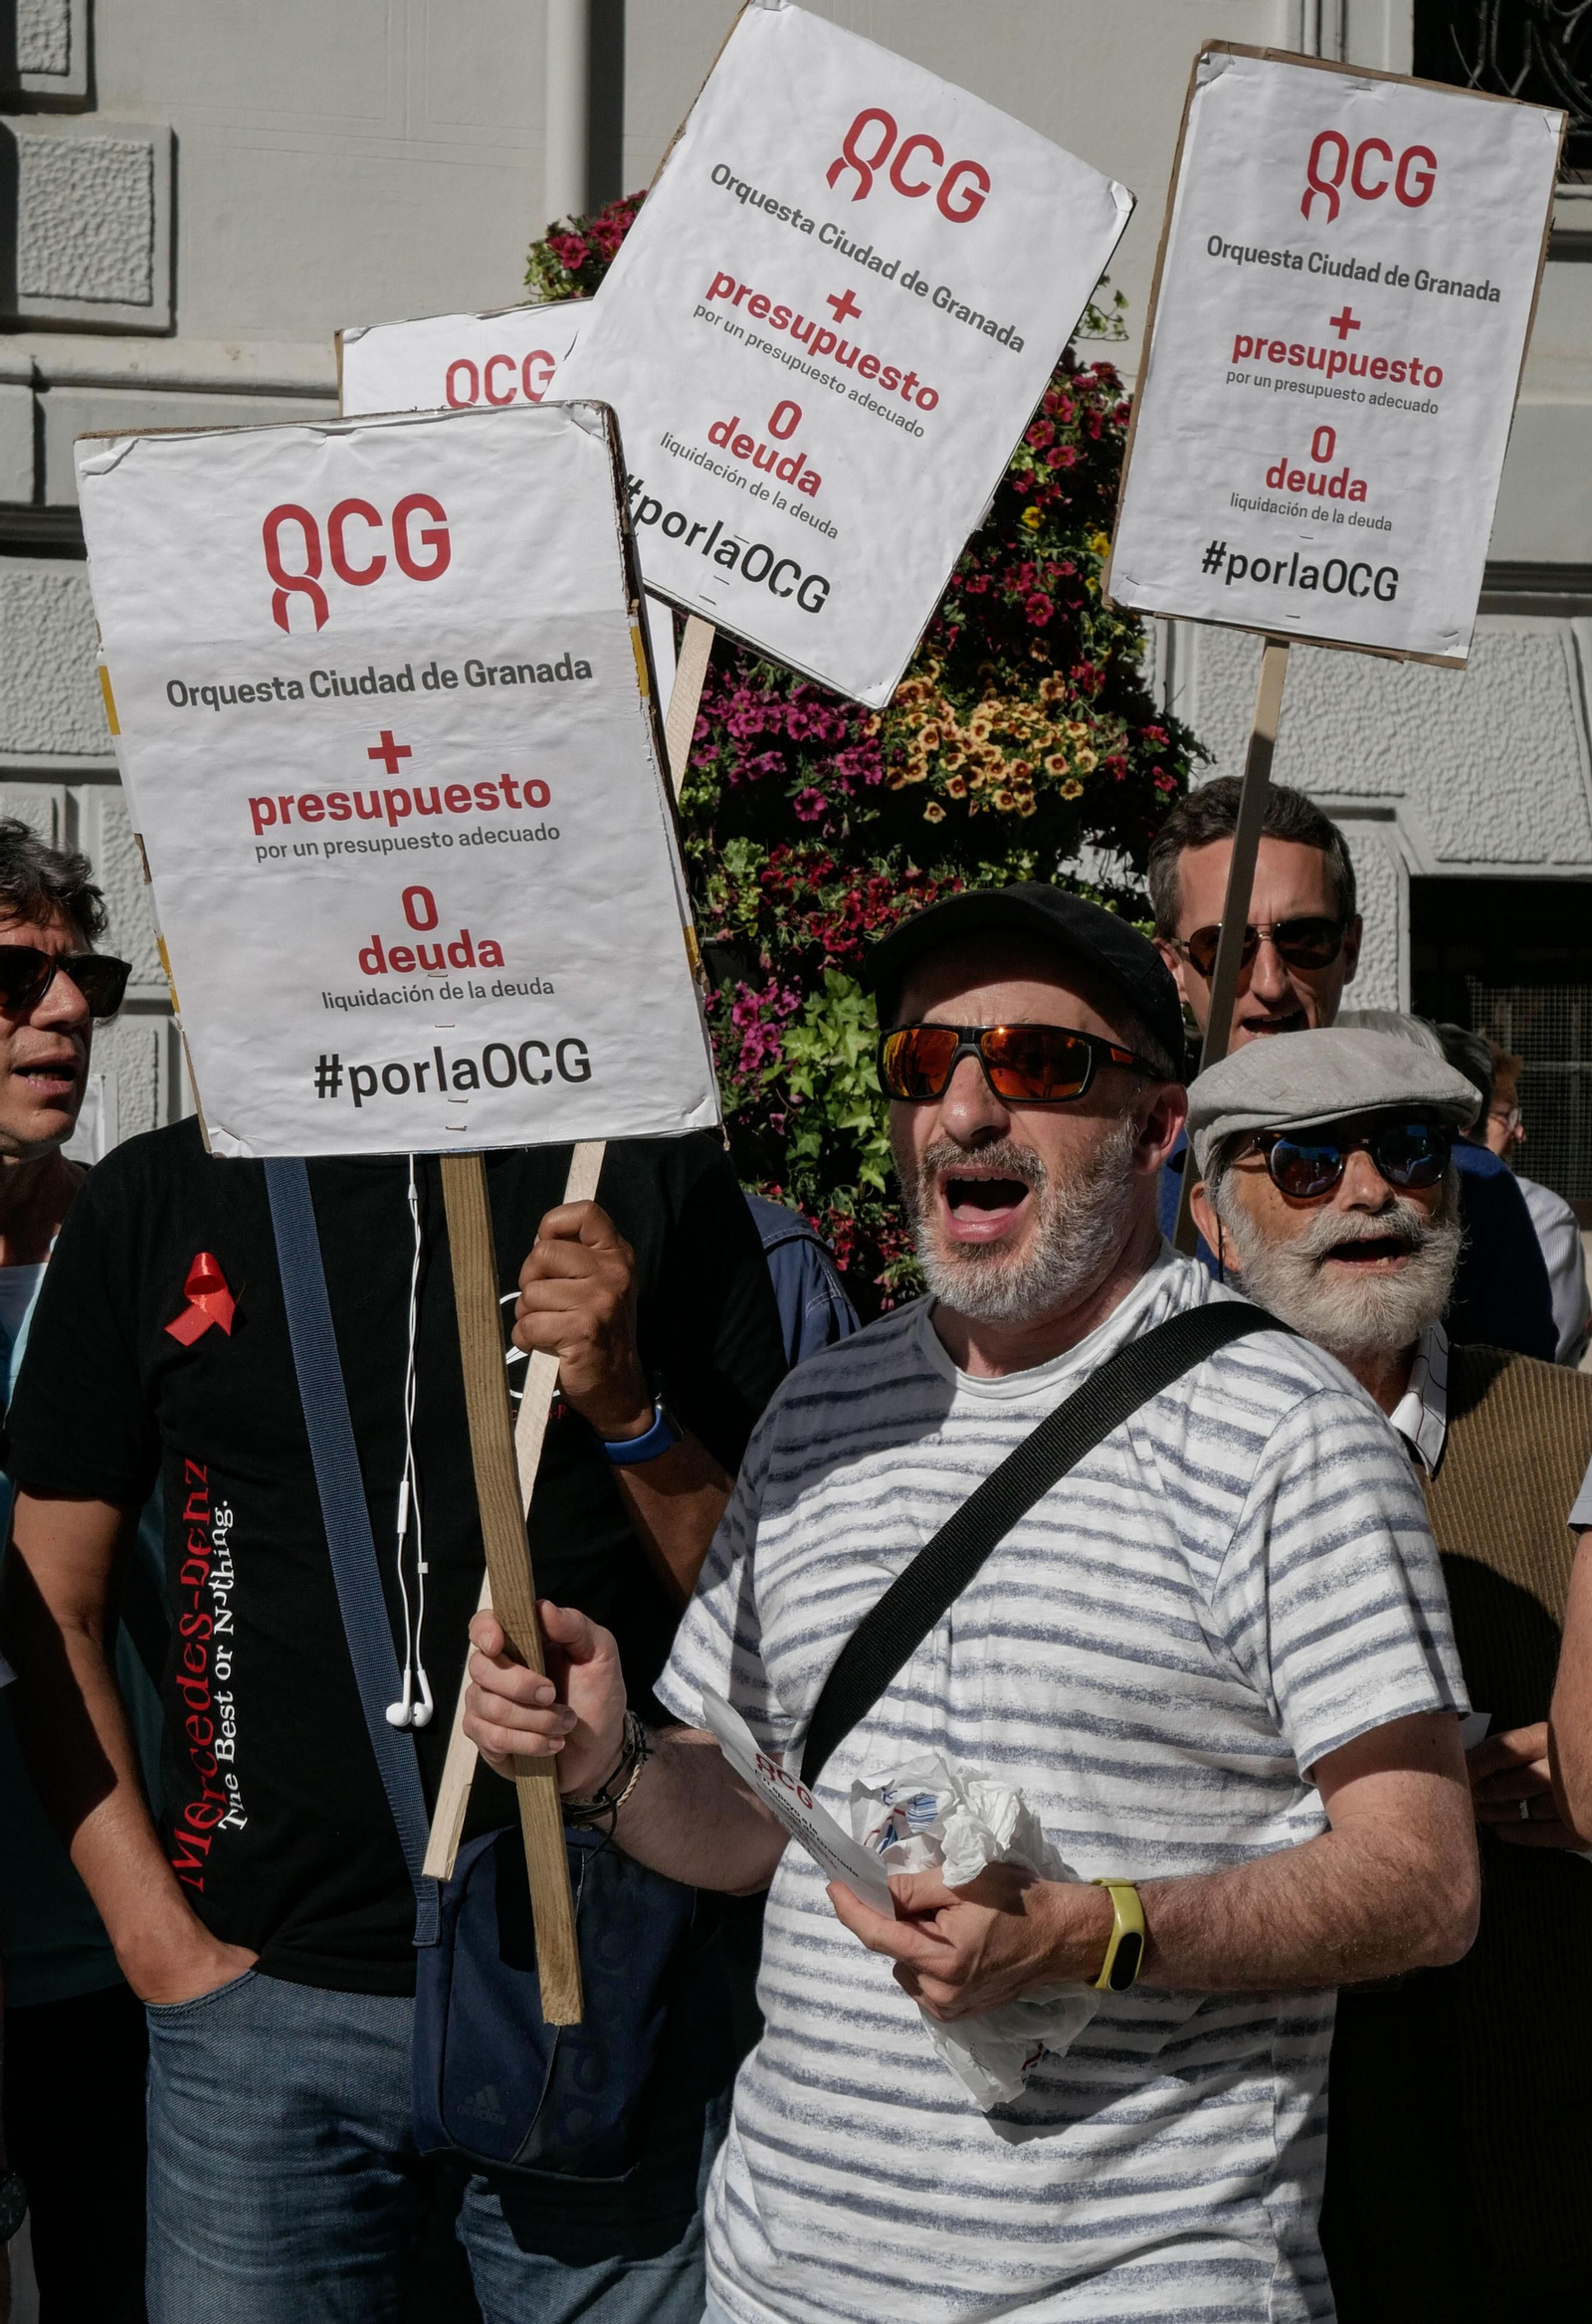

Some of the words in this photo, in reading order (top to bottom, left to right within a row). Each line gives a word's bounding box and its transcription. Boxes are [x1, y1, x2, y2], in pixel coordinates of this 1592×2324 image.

[825, 107, 991, 224] OCG
[1299, 129, 1438, 224] OCG
[710, 163, 816, 235] Orquesta
[818, 222, 902, 281] Ciudad
[899, 270, 929, 297] de
[931, 286, 1025, 354] Granada
[1207, 235, 1303, 271] Orquesta
[1307, 251, 1382, 284] Ciudad
[1384, 265, 1410, 289] de
[1414, 269, 1501, 303] Granada
[693, 303, 723, 325] por
[723, 320, 744, 339] un
[744, 333, 847, 394] presupuesto
[848, 389, 924, 438] adecuado
[705, 272, 939, 412] presupuesto
[1232, 334, 1444, 389] presupuesto
[446, 349, 556, 409] OCG
[1226, 371, 1252, 385] por
[1253, 375, 1272, 388] un
[1274, 378, 1366, 403] presupuesto
[1368, 391, 1439, 415] adecuado
[660, 431, 747, 489] liquidación
[748, 482, 770, 501] de
[771, 490, 788, 510] la
[789, 502, 839, 540] deuda
[707, 416, 822, 497] deuda
[1266, 458, 1368, 502] deuda
[1230, 491, 1308, 518] liquidación
[1310, 505, 1329, 521] de
[1331, 507, 1345, 524] la
[1347, 511, 1392, 531] deuda
[262, 492, 452, 633] OCG
[626, 474, 831, 614] #porlaOCG
[1201, 539, 1399, 602] #porlaOCG
[166, 677, 305, 712] Orquesta
[308, 663, 416, 698] Ciudad
[421, 661, 460, 690] de
[464, 652, 593, 687] Granada
[248, 773, 551, 836] presupuesto
[255, 845, 288, 864] por
[293, 842, 319, 858] un
[322, 832, 454, 860] presupuesto
[458, 822, 560, 847] adecuado
[358, 929, 504, 976] deuda
[321, 984, 435, 1012] liquidación
[439, 981, 465, 1000] de
[468, 980, 487, 999] la
[491, 976, 555, 998] deuda
[313, 1038, 592, 1108] #porlaOCG
[214, 1645, 234, 1682] or
[213, 1691, 237, 1765] Best
[756, 1753, 814, 1811] OCG
